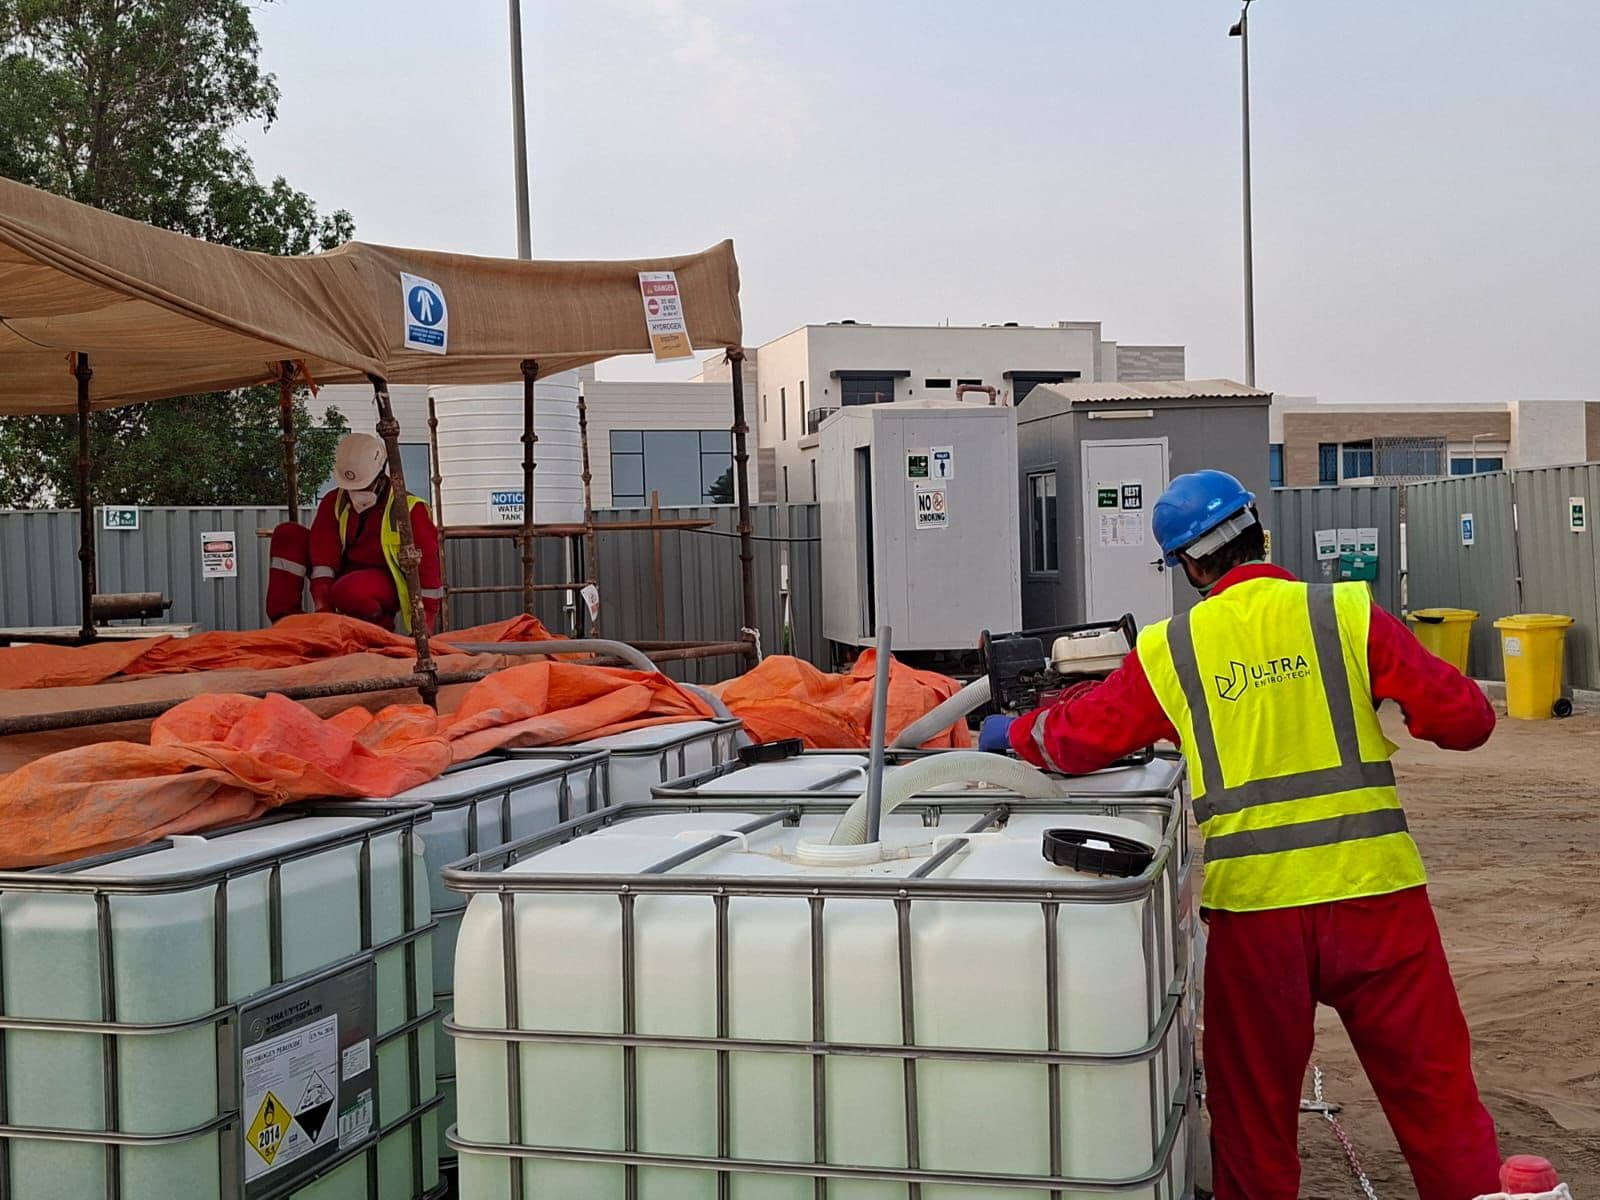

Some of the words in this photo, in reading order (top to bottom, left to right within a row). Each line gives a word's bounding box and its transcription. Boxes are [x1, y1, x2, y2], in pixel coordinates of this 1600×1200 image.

[652, 322, 682, 331] HYDROGEN
[1125, 486, 1139, 496] REST
[492, 493, 524, 503] NOTIC
[919, 494, 931, 511] NO
[1125, 498, 1140, 508] AREA
[920, 512, 945, 522] SMOKING
[1250, 654, 1308, 680] ULTRA
[1254, 669, 1311, 688] ENIRO-TECH
[259, 1125, 280, 1148] 2014
